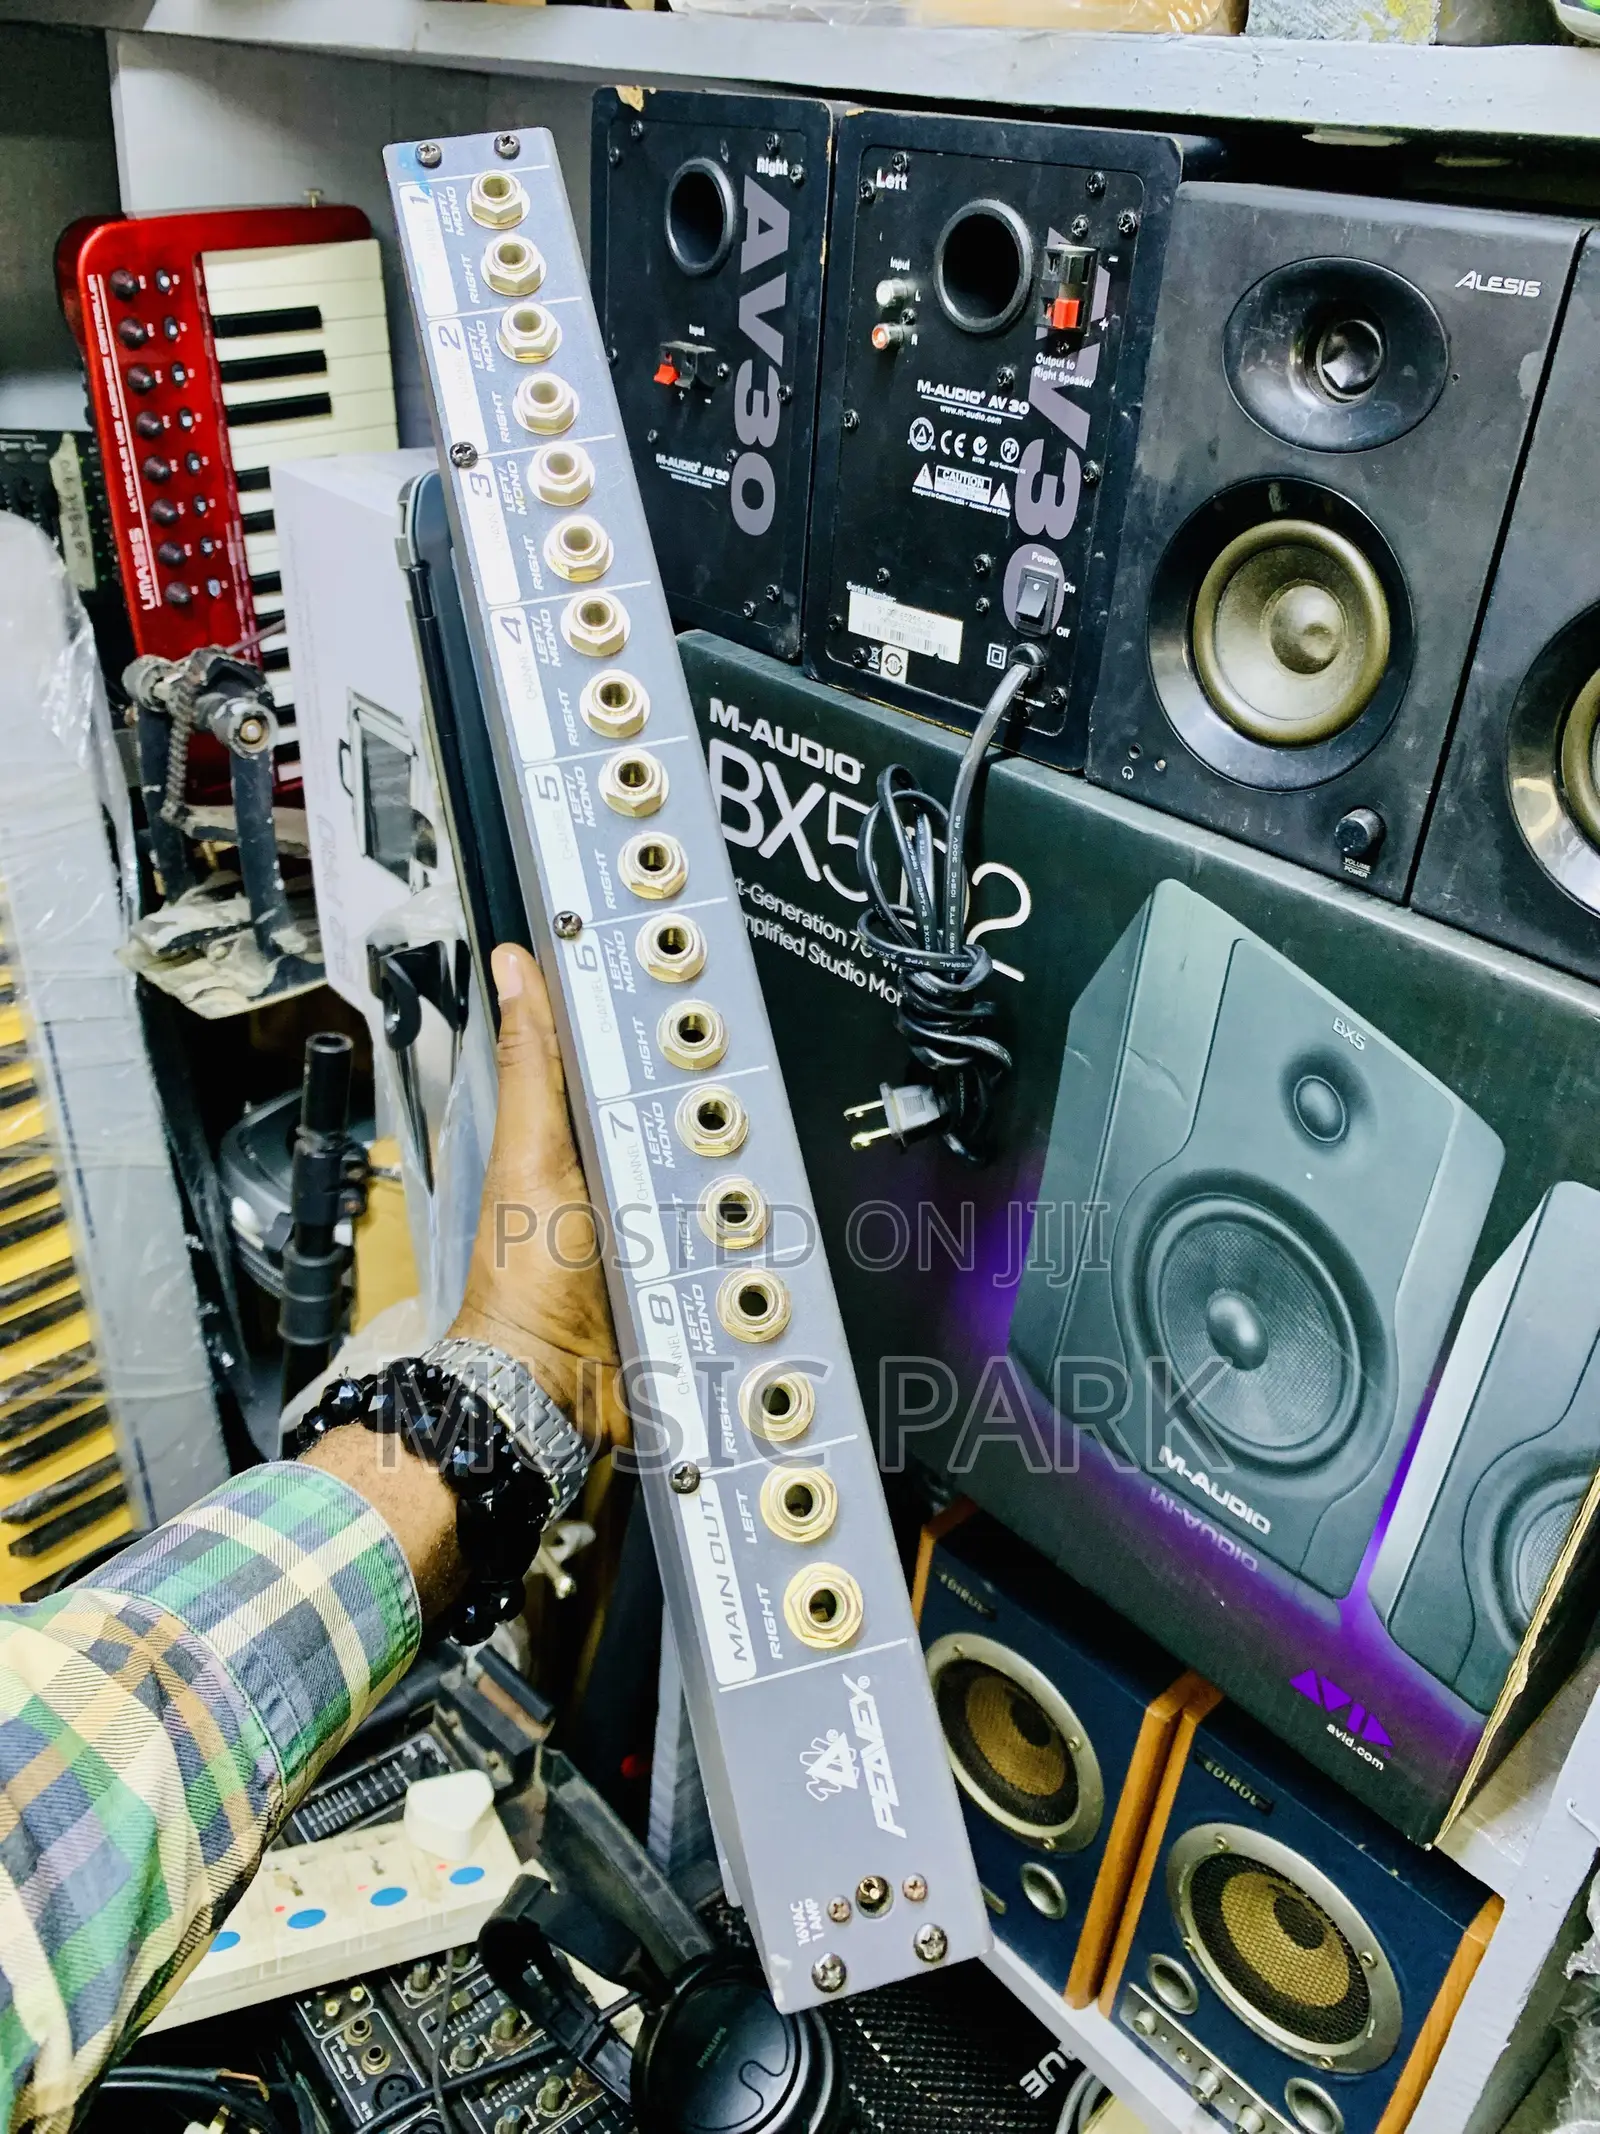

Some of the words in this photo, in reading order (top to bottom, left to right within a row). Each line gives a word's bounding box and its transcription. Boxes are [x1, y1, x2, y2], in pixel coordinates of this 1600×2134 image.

[757, 155, 789, 177] Right
[876, 167, 908, 191] Left
[437, 192, 454, 233] LEFT/
[446, 186, 465, 236] MONO
[460, 254, 480, 304] RIGHT
[1455, 270, 1541, 298] ALESIS
[438, 325, 461, 351] 2
[467, 326, 485, 370] LEFT/
[476, 319, 496, 372] MONO
[1036, 352, 1065, 368] Output
[1066, 359, 1076, 370] to
[917, 379, 987, 405] M-AUDIO
[988, 395, 1008, 410] AV
[1008, 400, 1030, 415] 30
[1034, 366, 1057, 381] Right
[1058, 371, 1094, 388] Speaker
[491, 391, 512, 443] RIGHT
[469, 472, 493, 498] 3
[507, 460, 527, 516] MONO
[655, 453, 702, 474] M-AUDIO
[942, 470, 985, 489] CAUTION
[497, 467, 516, 512] LEFT/
[523, 535, 544, 591] RIGHT
[1031, 551, 1058, 567] Power
[1063, 582, 1076, 594] On
[500, 616, 521, 645] 4
[530, 615, 550, 664] LEFT/
[540, 608, 563, 667] MONO
[1056, 626, 1071, 639] Off
[557, 688, 580, 747] RIGHT
[709, 697, 863, 785] M-AUDIO
[535, 774, 559, 802] 5
[564, 773, 584, 825] LEFT/
[574, 766, 596, 828] MONO
[593, 849, 617, 910] RIGHT
[735, 877, 847, 947] t-Generation
[572, 944, 598, 972] 6
[603, 938, 625, 991] LEFT/
[613, 930, 637, 994] MONO
[808, 943, 867, 988] Studio
[632, 1016, 656, 1080] RIGHT
[1332, 1017, 1366, 1051] BX5
[608, 1111, 635, 1140] 7
[641, 1110, 663, 1165] LEFT/
[652, 1102, 676, 1169] MONO
[627, 1143, 649, 1200] CHANNEL
[671, 1193, 696, 1261] RIGHT
[648, 1293, 675, 1326] 8
[681, 1292, 703, 1352] LEFT/
[692, 1283, 717, 1355] MONO
[667, 1332, 690, 1395] CHANNEL
[712, 1382, 738, 1454] RIGHT
[1158, 1445, 1271, 1535] M-AUDIO
[700, 1494, 726, 1565] OUT
[735, 1489, 758, 1544] LEFT
[716, 1574, 748, 1662] MAIN
[756, 1583, 783, 1660] RIGHT
[1326, 1723, 1385, 1771] avid.com
[1203, 1760, 1257, 1806] EDIROL
[790, 1900, 812, 1948] 16VAC
[804, 1897, 823, 1931] AMP
